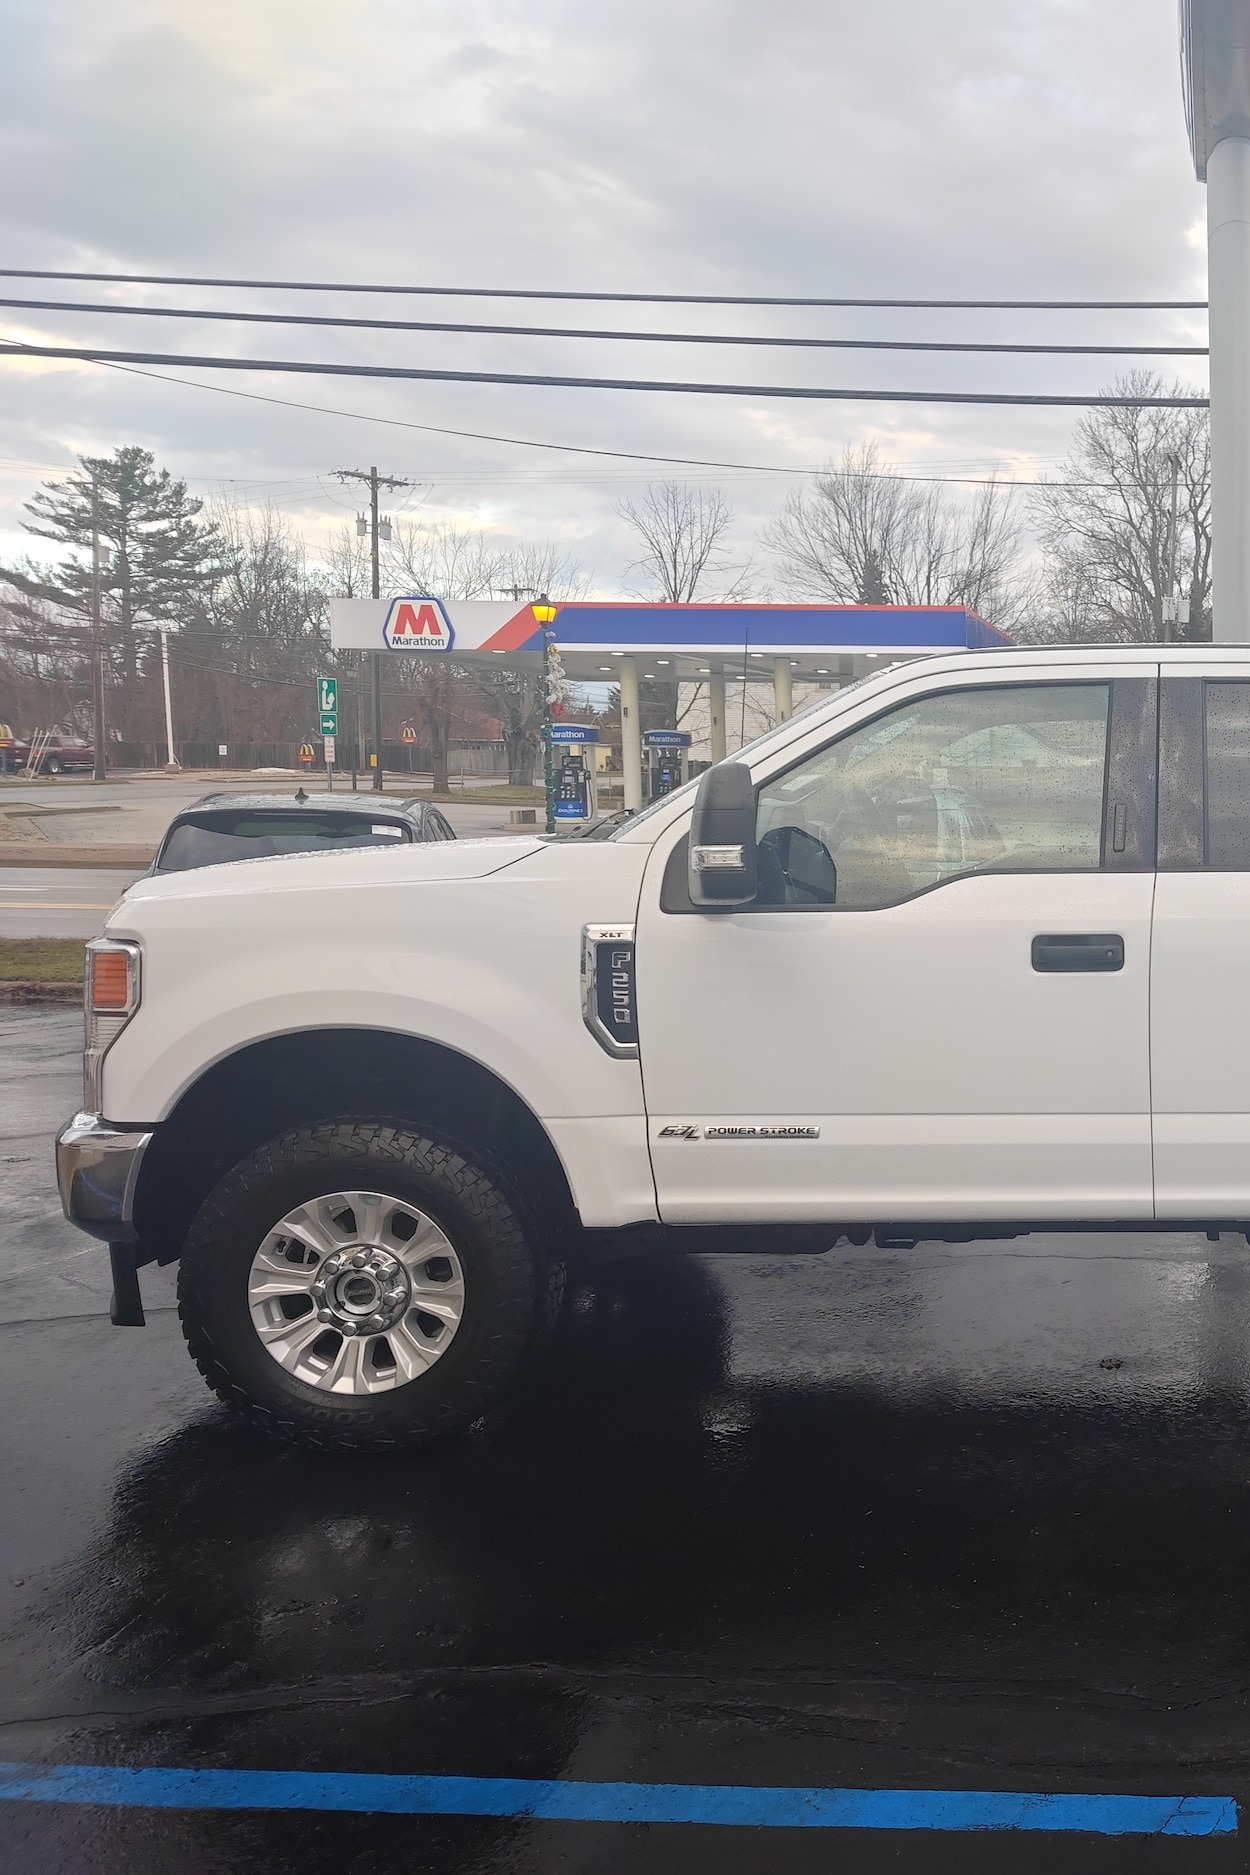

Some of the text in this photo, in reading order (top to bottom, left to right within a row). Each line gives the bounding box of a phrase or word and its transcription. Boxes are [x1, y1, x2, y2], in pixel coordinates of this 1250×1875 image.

[394, 604, 442, 635] M
[392, 636, 444, 646] Marathon
[708, 1127, 756, 1135] POWER
[759, 1127, 816, 1135] STROKE
